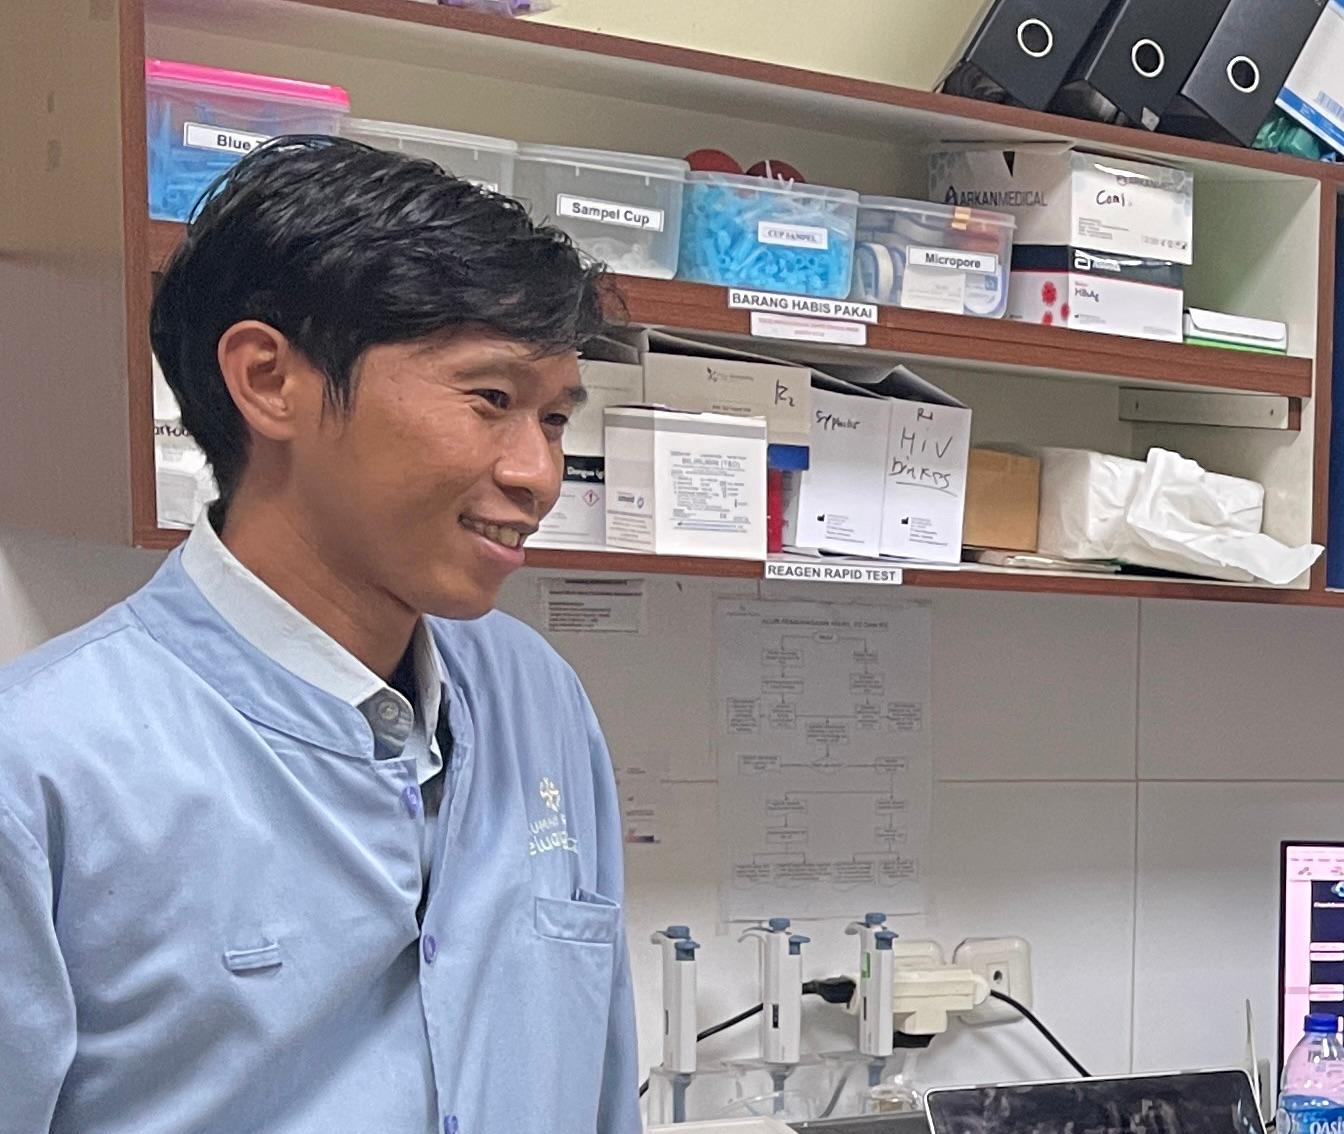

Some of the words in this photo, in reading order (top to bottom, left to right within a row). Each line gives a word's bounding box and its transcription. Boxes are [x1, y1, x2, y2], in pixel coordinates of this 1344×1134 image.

[217, 135, 251, 151] Blue
[572, 202, 620, 222] Sampel
[624, 210, 650, 228] Cup
[925, 252, 981, 269] Micropore
[732, 292, 789, 309] BARANG
[791, 300, 831, 314] HABIS
[834, 304, 872, 318] PAKAI
[767, 565, 821, 578] REAGEN
[824, 567, 863, 580] RAPID
[867, 569, 896, 581] TEST
